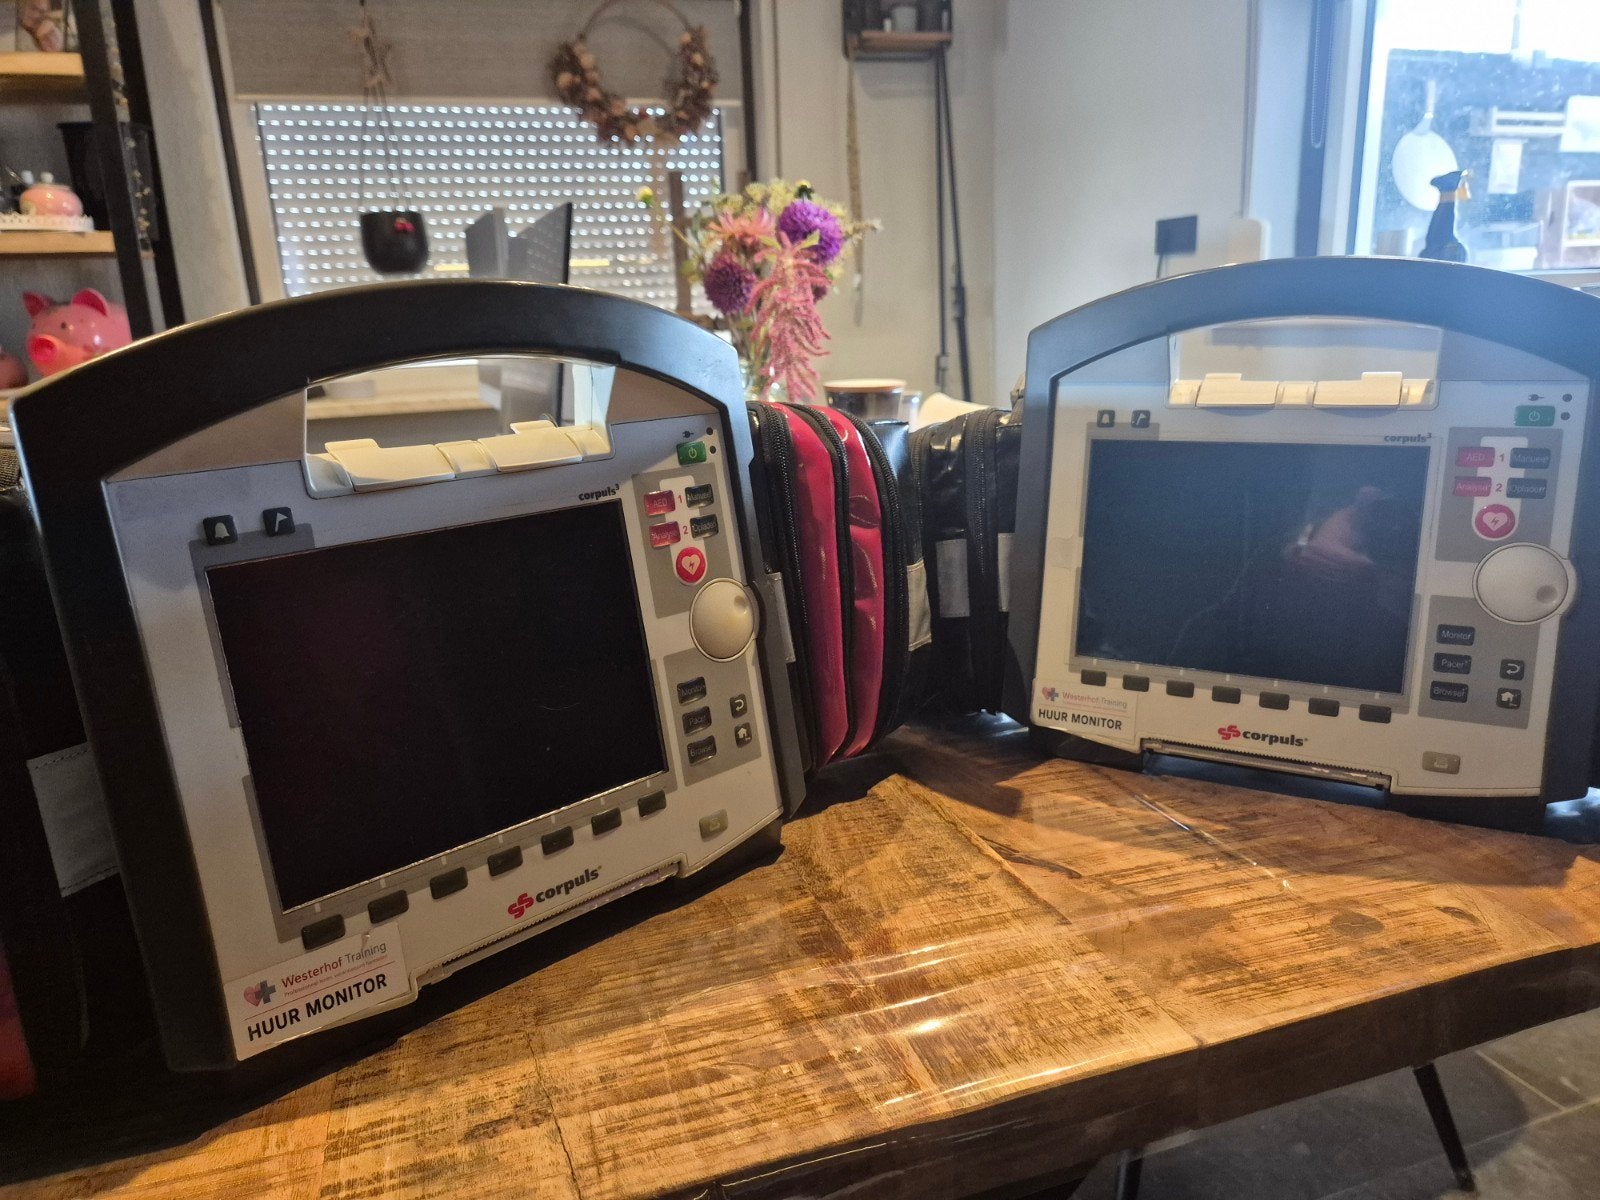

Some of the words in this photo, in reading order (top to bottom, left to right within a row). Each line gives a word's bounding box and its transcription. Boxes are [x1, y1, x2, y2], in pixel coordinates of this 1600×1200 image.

[1466, 453, 1485, 462] AED
[1499, 453, 1505, 462] 1
[1495, 483, 1503, 493] 2
[652, 497, 668, 508] AED
[678, 495, 683, 504] 1
[683, 525, 689, 535] 2
[1441, 629, 1472, 640] Monitor
[1441, 658, 1465, 667] Pacer
[1433, 686, 1466, 697] Browser
[1062, 691, 1099, 704] Westerhof
[1101, 698, 1127, 709] Training
[1038, 708, 1068, 722] HUUR
[1071, 713, 1122, 730] MONITOR
[1242, 730, 1304, 747] corpuls
[535, 867, 600, 903] corpuls
[281, 956, 343, 988] Westerhof
[345, 942, 387, 963] Training
[247, 1008, 301, 1042] HUUR
[305, 973, 388, 1018] MONITOR
